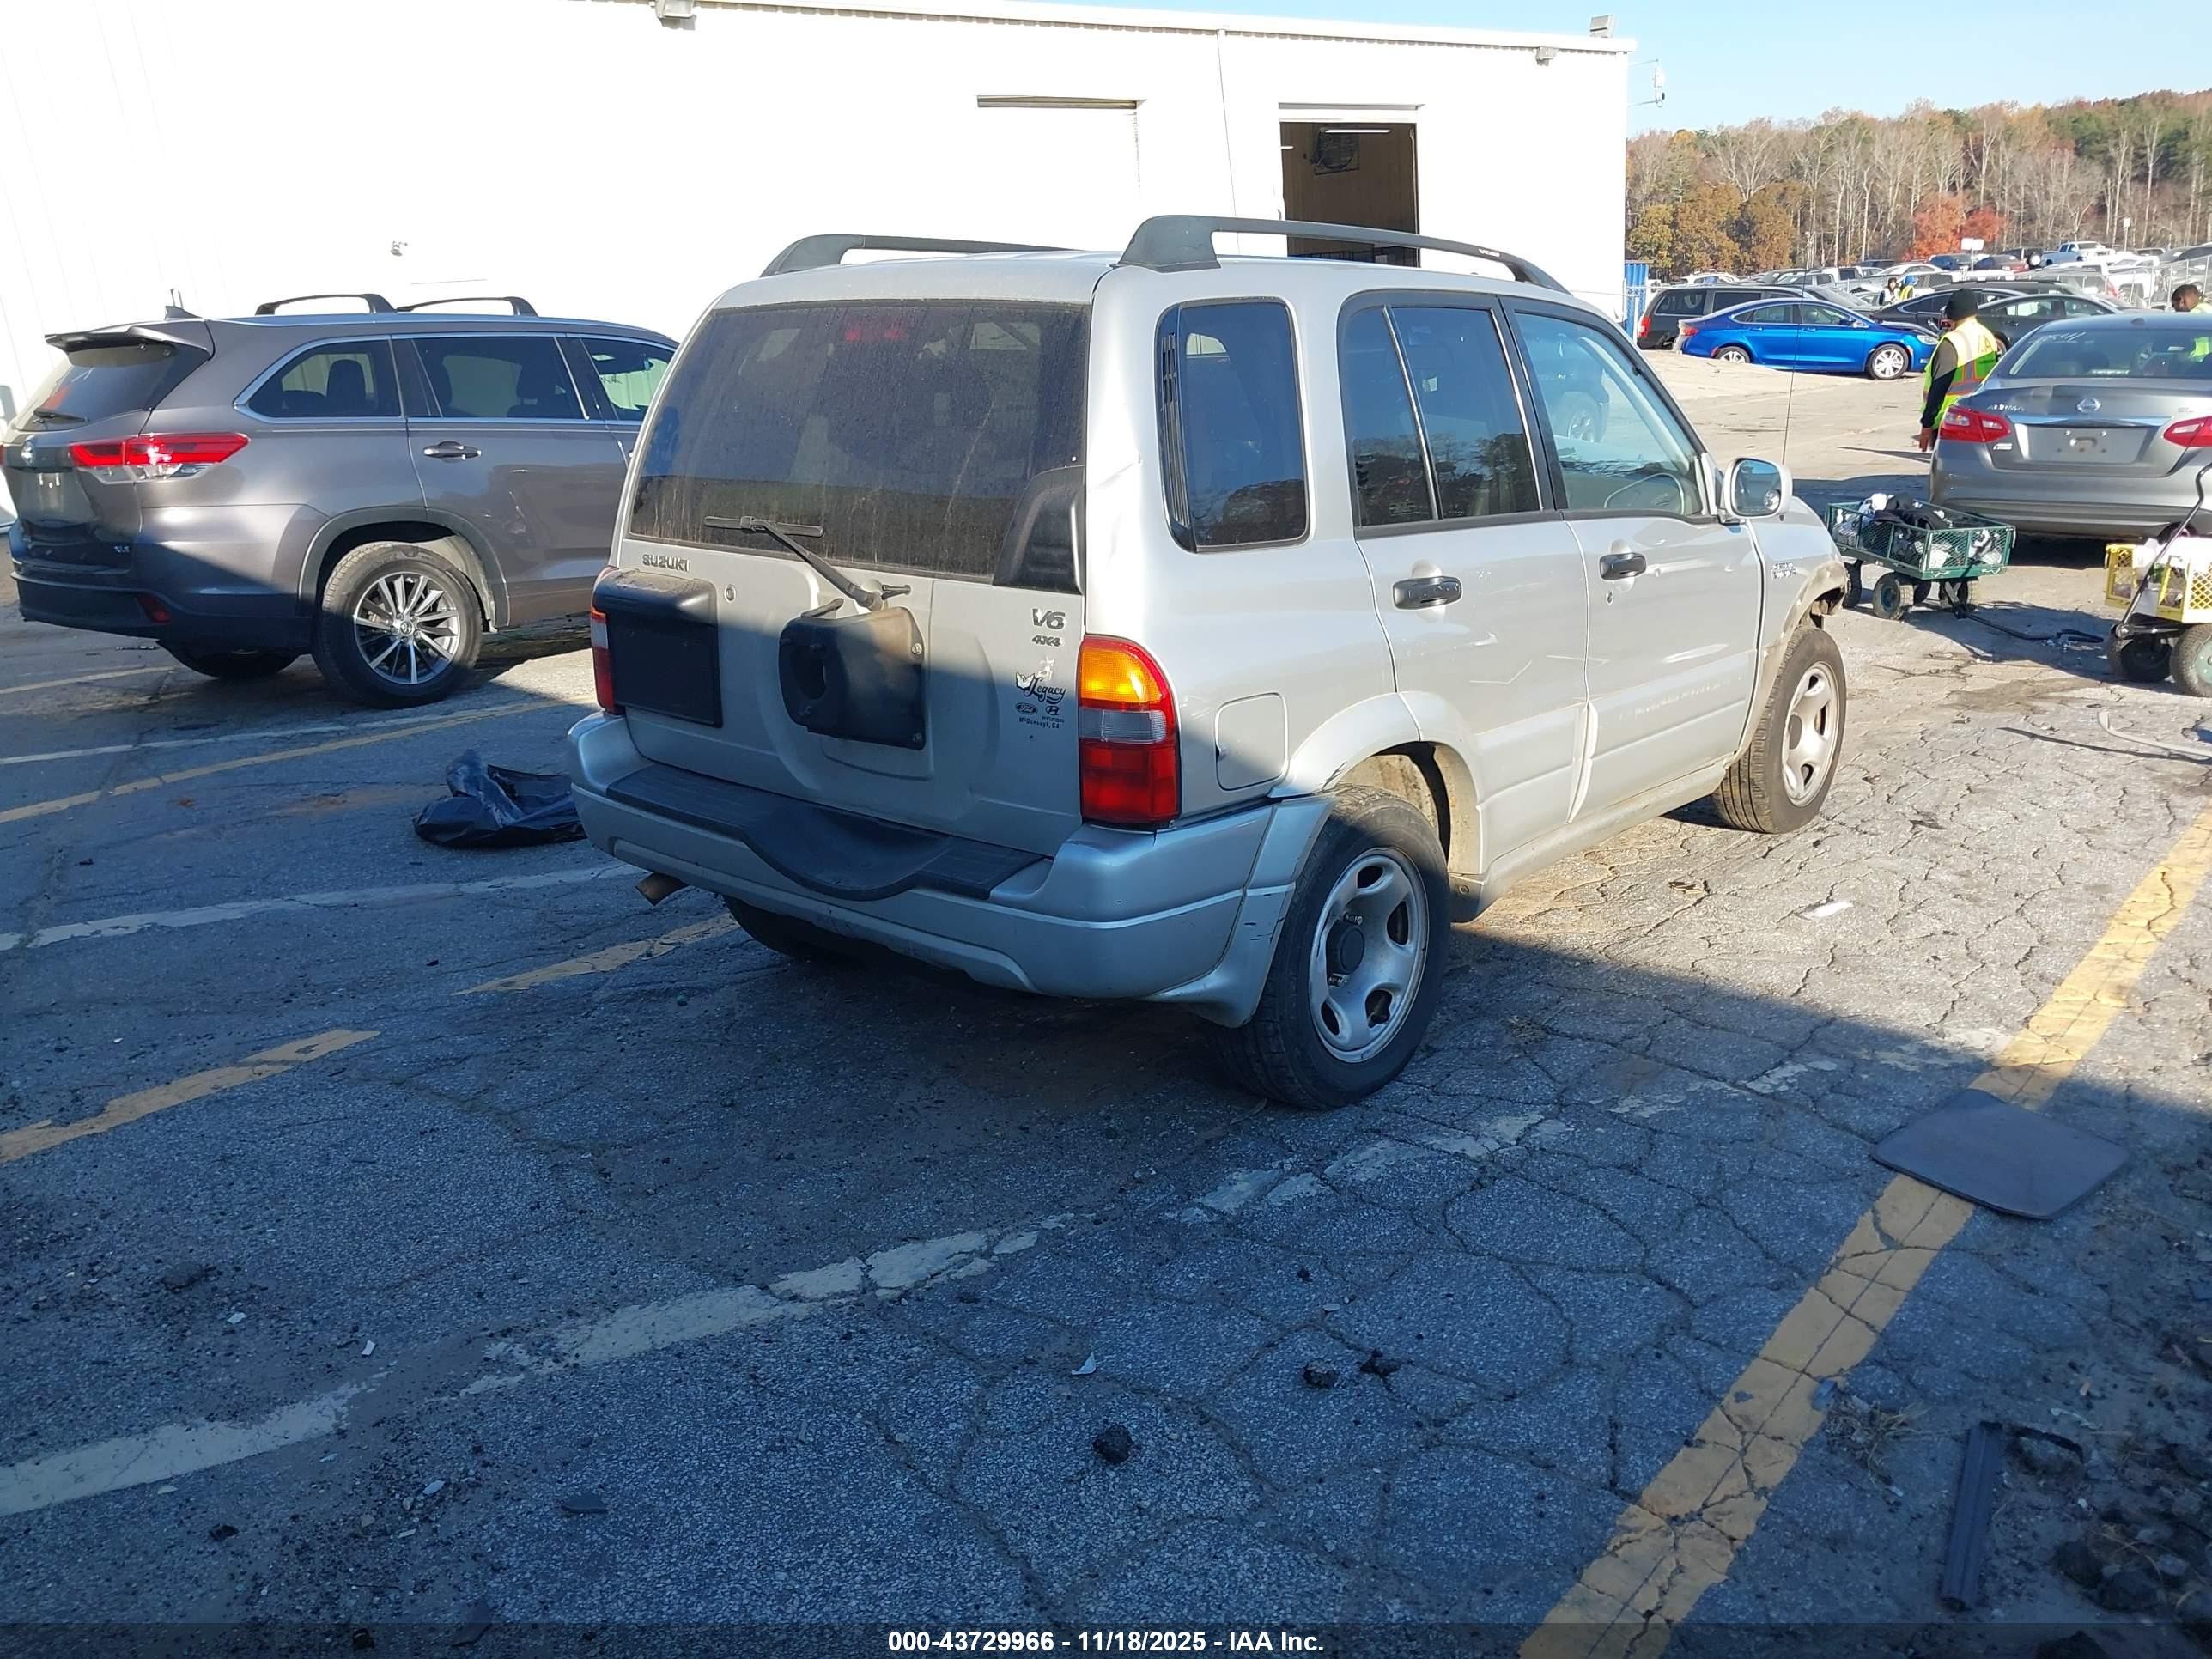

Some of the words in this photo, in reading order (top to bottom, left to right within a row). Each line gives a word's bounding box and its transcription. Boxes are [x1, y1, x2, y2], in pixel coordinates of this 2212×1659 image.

[642, 554, 691, 572] SUZUKI
[1033, 608, 1066, 630] V6
[1024, 676, 1066, 705] Legacy
